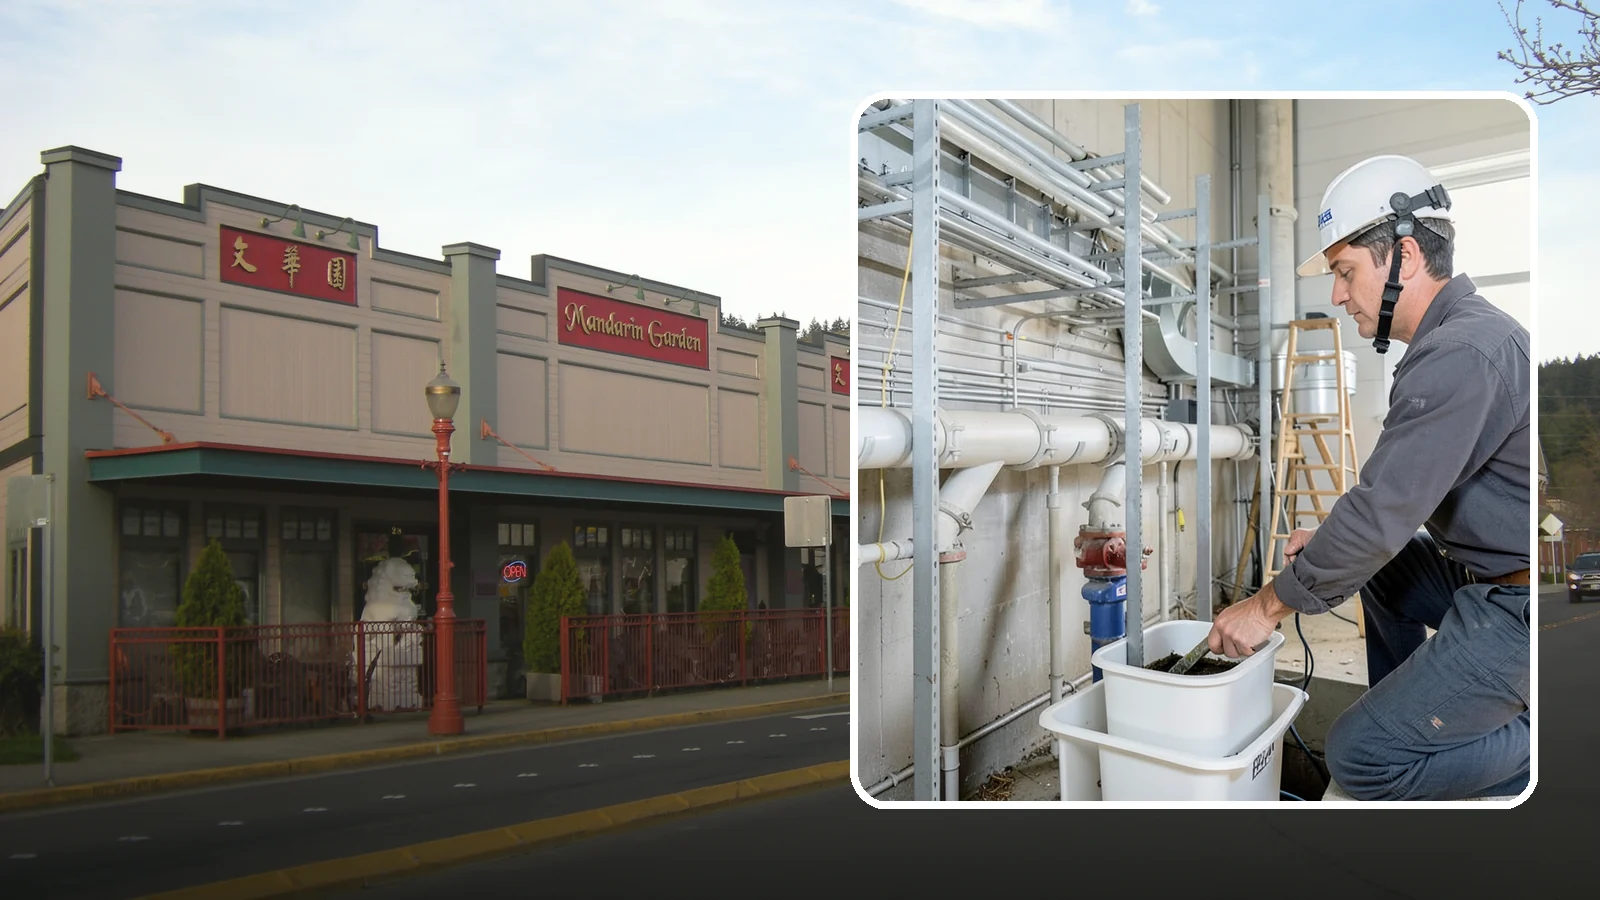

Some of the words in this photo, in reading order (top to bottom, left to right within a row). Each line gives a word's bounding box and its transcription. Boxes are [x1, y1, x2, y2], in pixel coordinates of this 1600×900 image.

[230, 235, 346, 291] 文華園
[564, 302, 644, 341] Mandarin
[648, 320, 702, 352] Garden
[503, 565, 527, 578] OPEN
